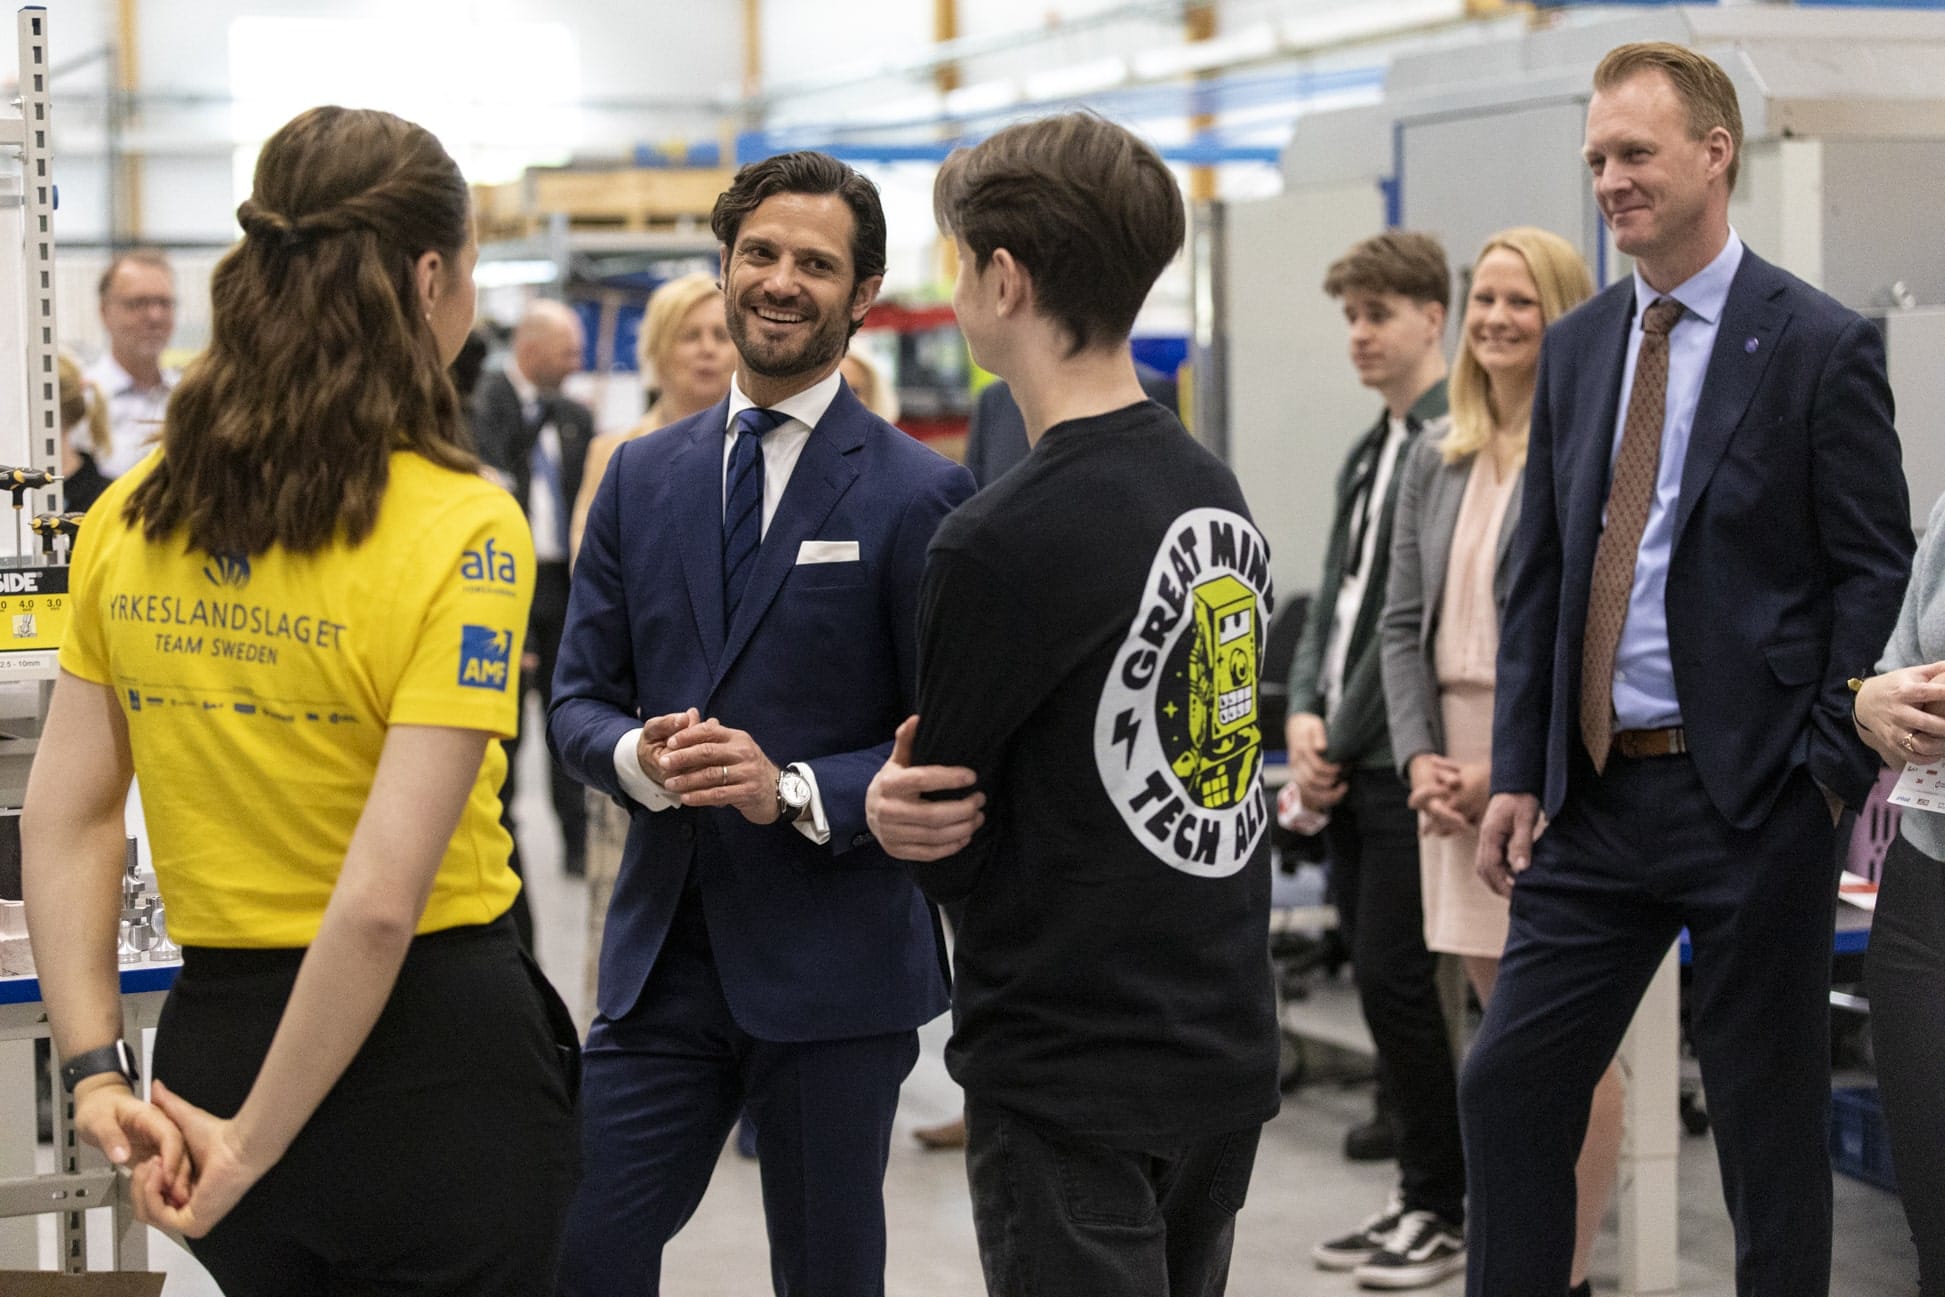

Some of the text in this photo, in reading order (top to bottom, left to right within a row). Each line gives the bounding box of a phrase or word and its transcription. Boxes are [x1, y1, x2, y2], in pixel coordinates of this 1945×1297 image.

[461, 538, 516, 584] afa
[19, 599, 34, 609] 4.0
[47, 598, 62, 608] 3.0
[110, 594, 346, 651] YRKESLANDSLAGET
[1122, 526, 1201, 690] GREAT
[155, 633, 278, 665] TEAM SWEDEN
[463, 657, 506, 685] AMF
[1128, 770, 1265, 865] TECH ALI
